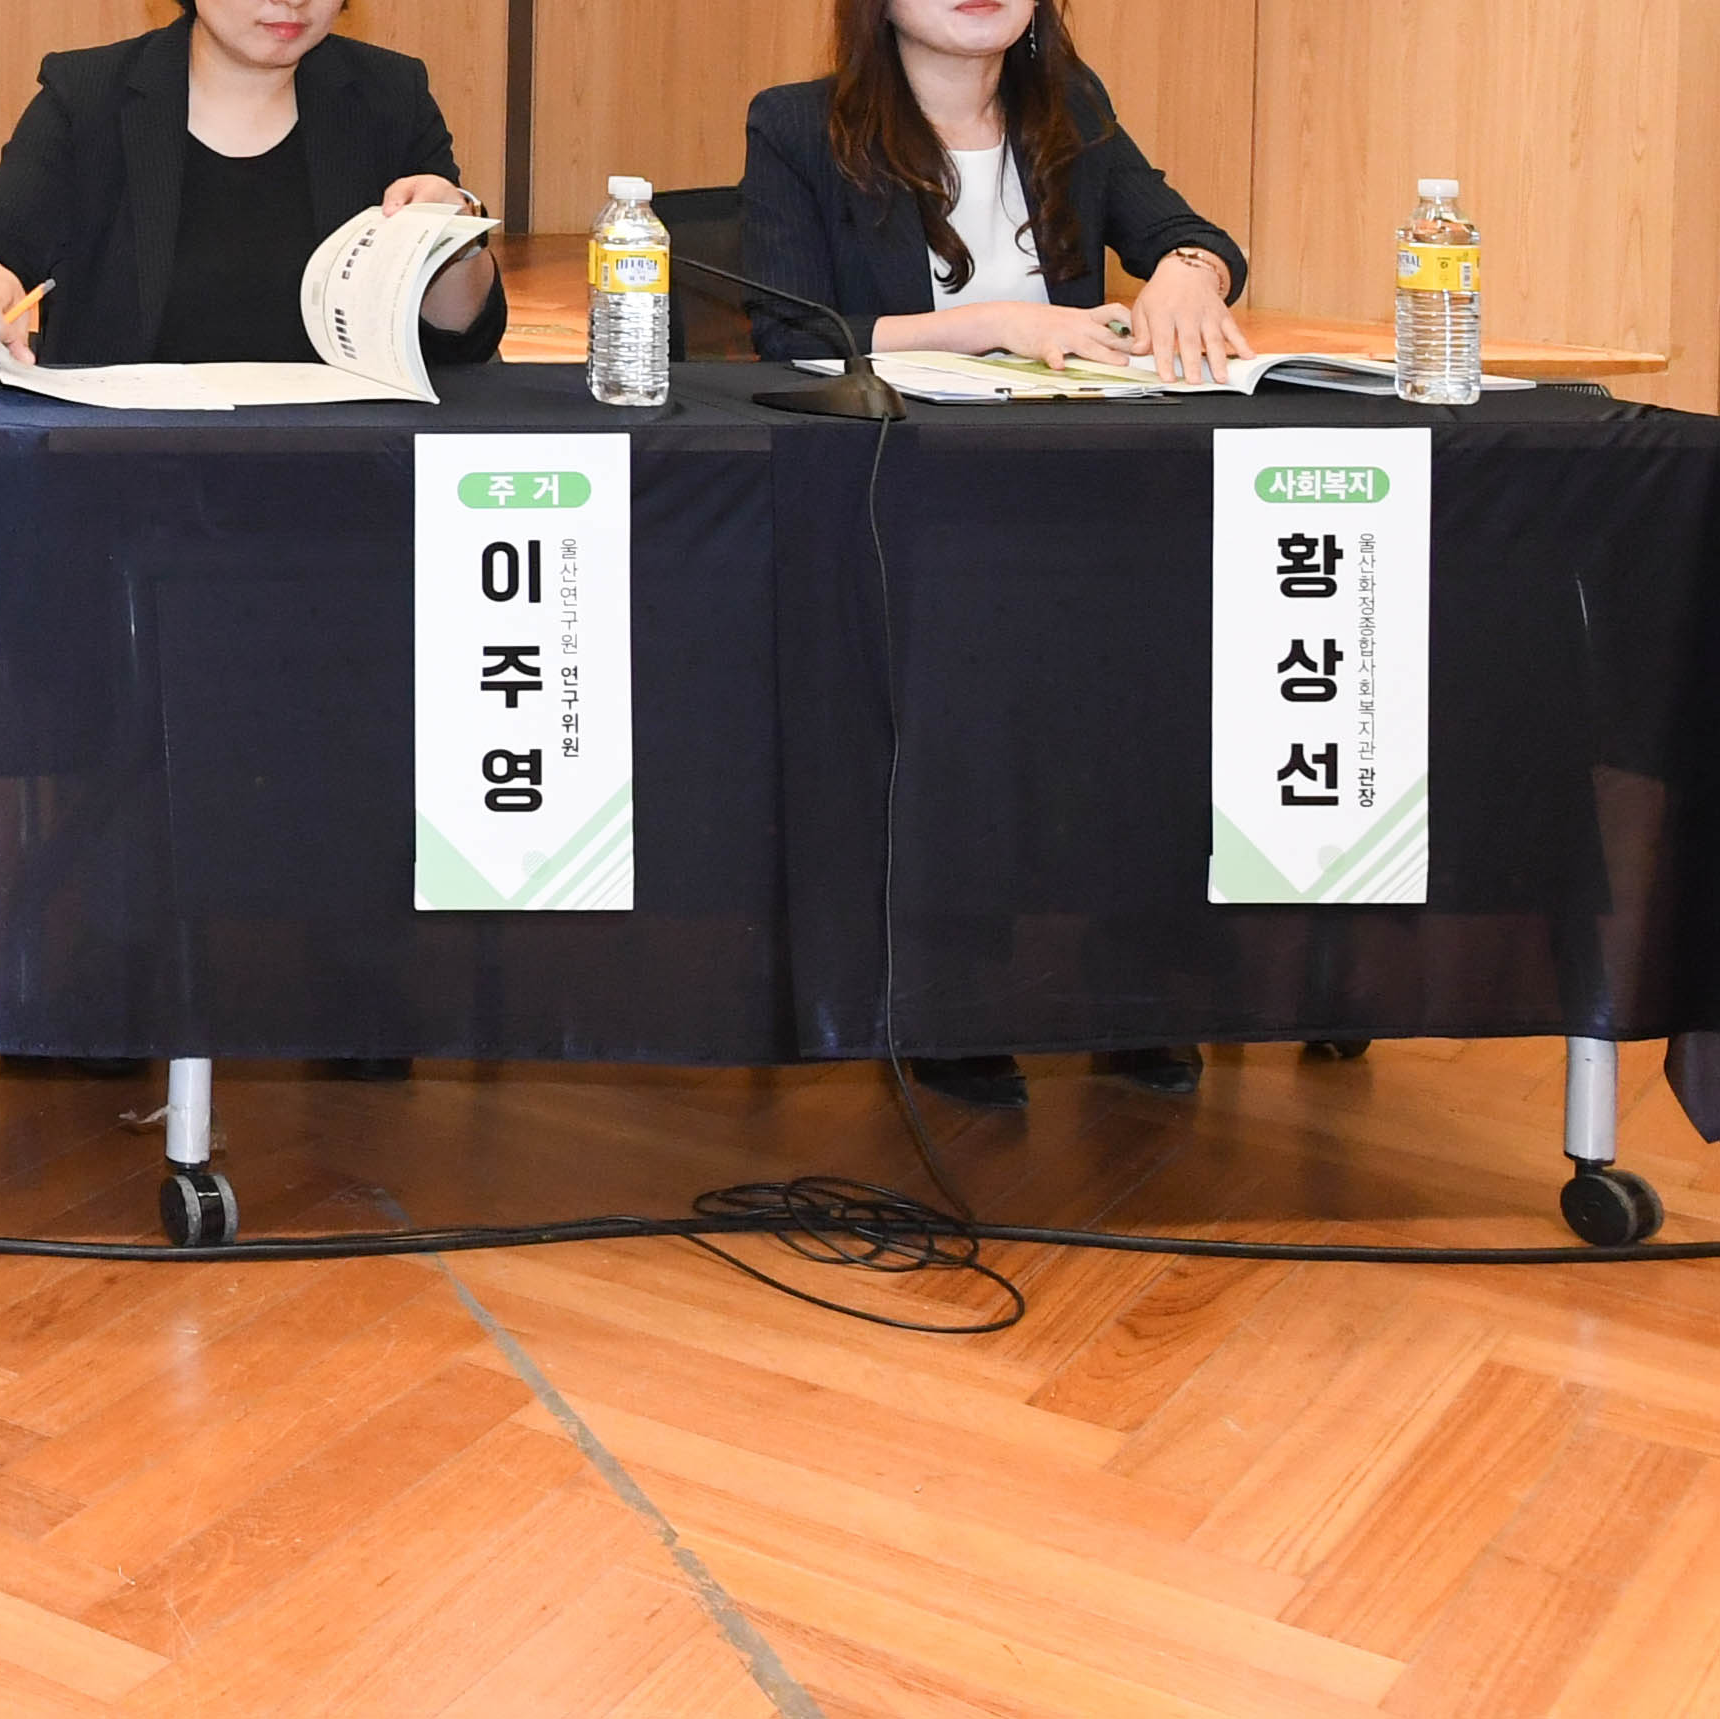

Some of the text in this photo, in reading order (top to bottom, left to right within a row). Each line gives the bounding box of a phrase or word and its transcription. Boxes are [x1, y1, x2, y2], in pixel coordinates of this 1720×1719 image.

[1268, 467, 1375, 500] 사회복지
[480, 537, 545, 813] 이주영
[559, 537, 580, 759] 울산연구원 연구위원
[1275, 532, 1345, 808] 황상선
[1356, 532, 1378, 809] 울산화정종합사회복지관 관장
